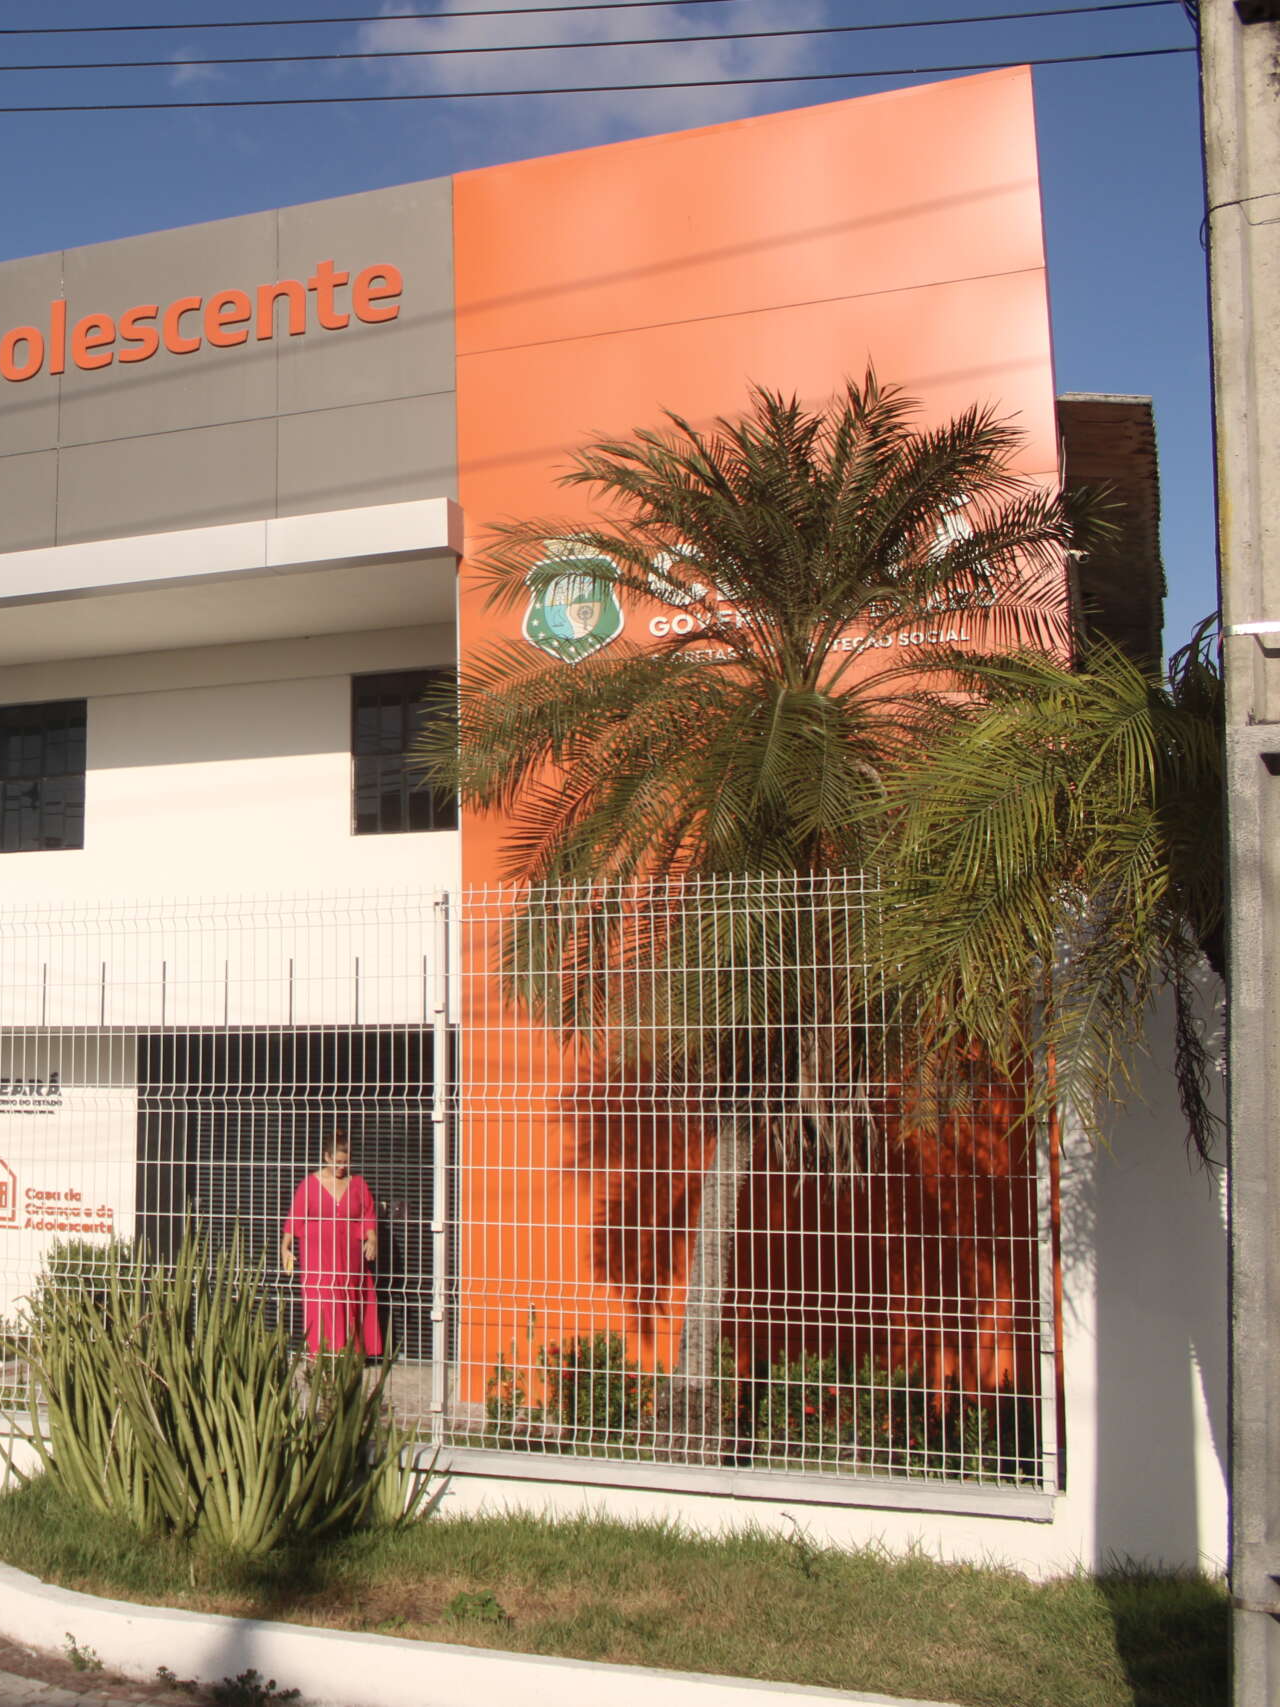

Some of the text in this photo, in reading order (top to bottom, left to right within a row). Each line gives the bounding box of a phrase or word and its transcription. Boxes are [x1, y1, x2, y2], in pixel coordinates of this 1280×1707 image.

[898, 627, 970, 646] SOCIAL
[32, 1099, 63, 1107] ESTADO
[25, 1187, 82, 1201] Casa da
[25, 1203, 81, 1220] Criança
[83, 1208, 93, 1217] e
[24, 1218, 113, 1234] Adolescente
